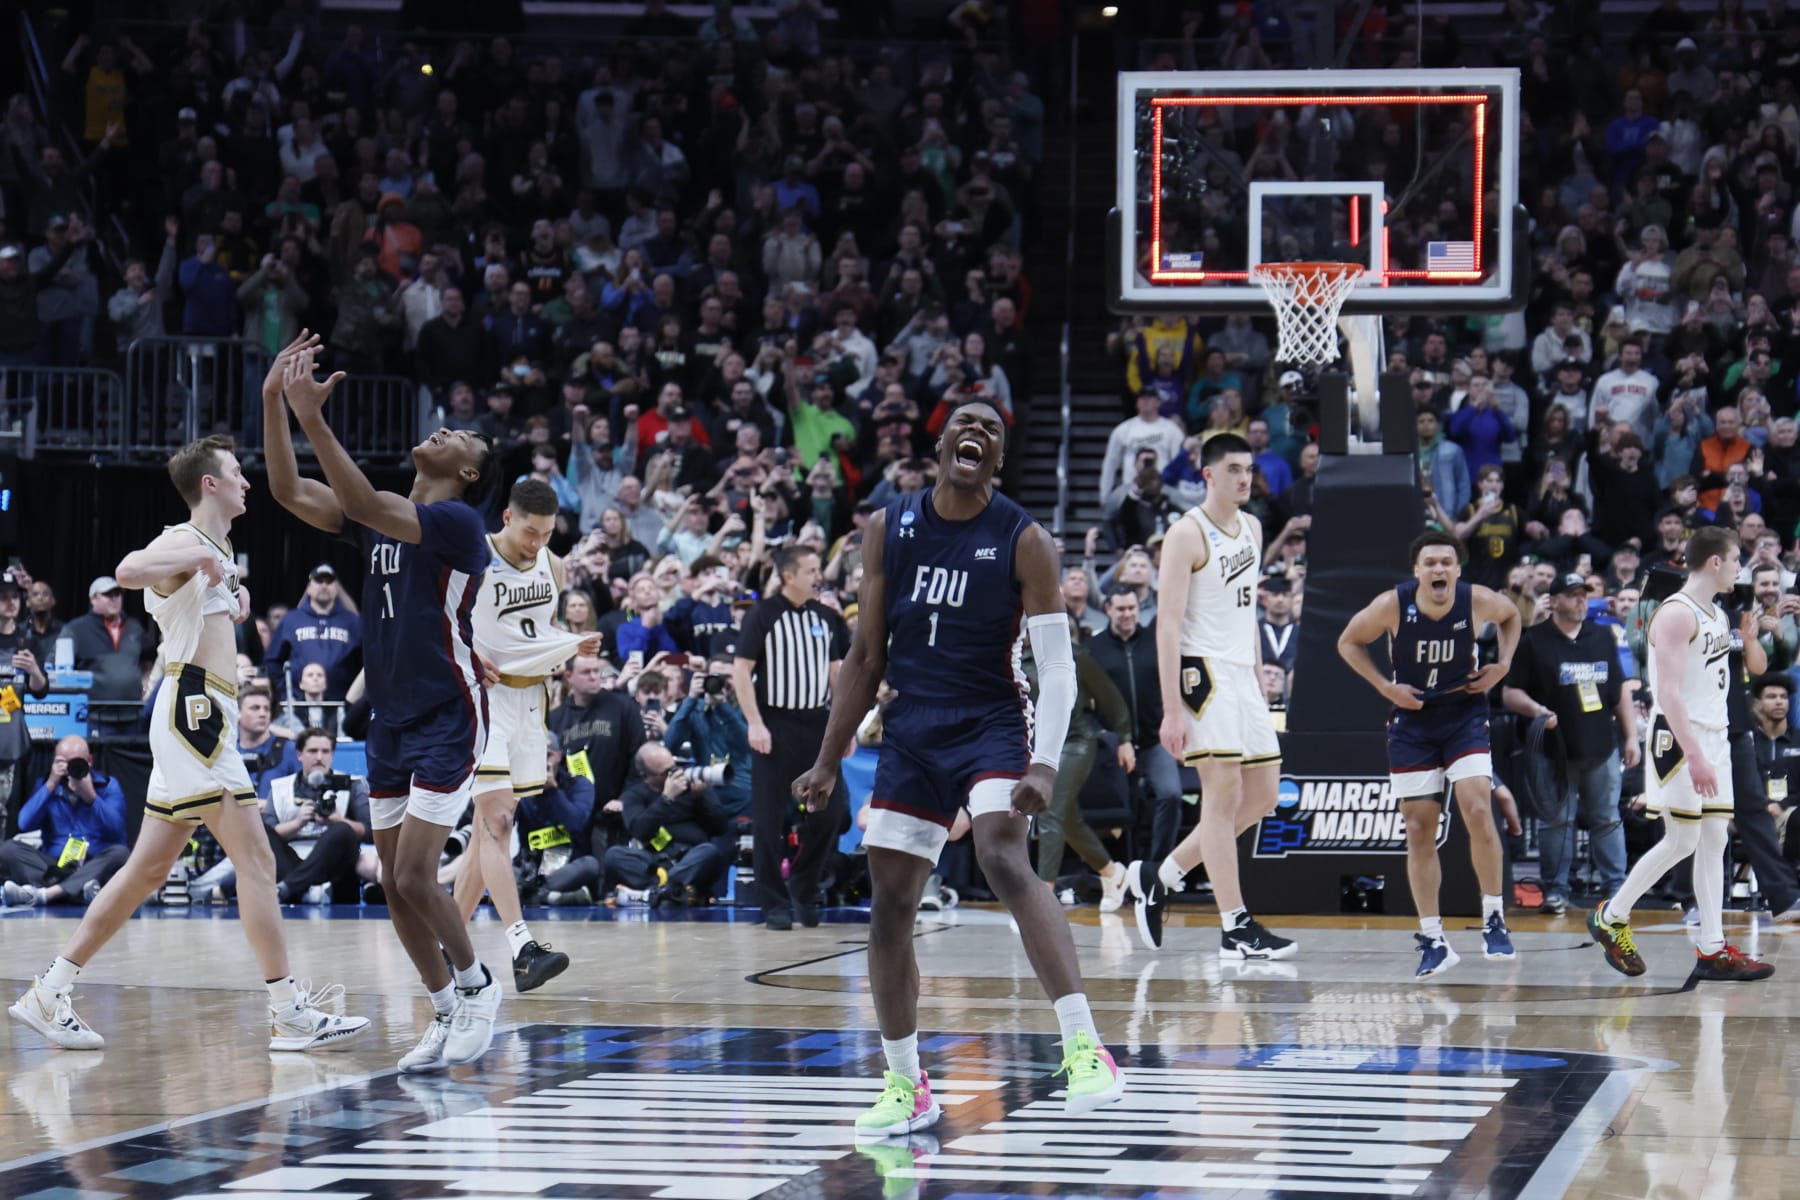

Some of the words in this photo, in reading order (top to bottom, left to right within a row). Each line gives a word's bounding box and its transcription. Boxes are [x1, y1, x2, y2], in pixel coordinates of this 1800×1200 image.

[974, 547, 997, 558] NEC
[493, 580, 553, 607] Purdue
[911, 565, 968, 608] FDU
[1236, 586, 1252, 607] 15
[296, 626, 318, 642] THE
[520, 617, 537, 638] 0
[928, 611, 939, 647] 1
[1416, 639, 1455, 664] FDU
[1426, 668, 1438, 689] 4
[1718, 668, 1726, 690] 3
[23, 703, 67, 714] WERADE
[184, 694, 212, 731] P
[1656, 729, 1674, 758] P
[1300, 782, 1402, 811] MARCH
[1311, 812, 1446, 840] MADNE
[172, 1072, 1010, 1200] MADNE
